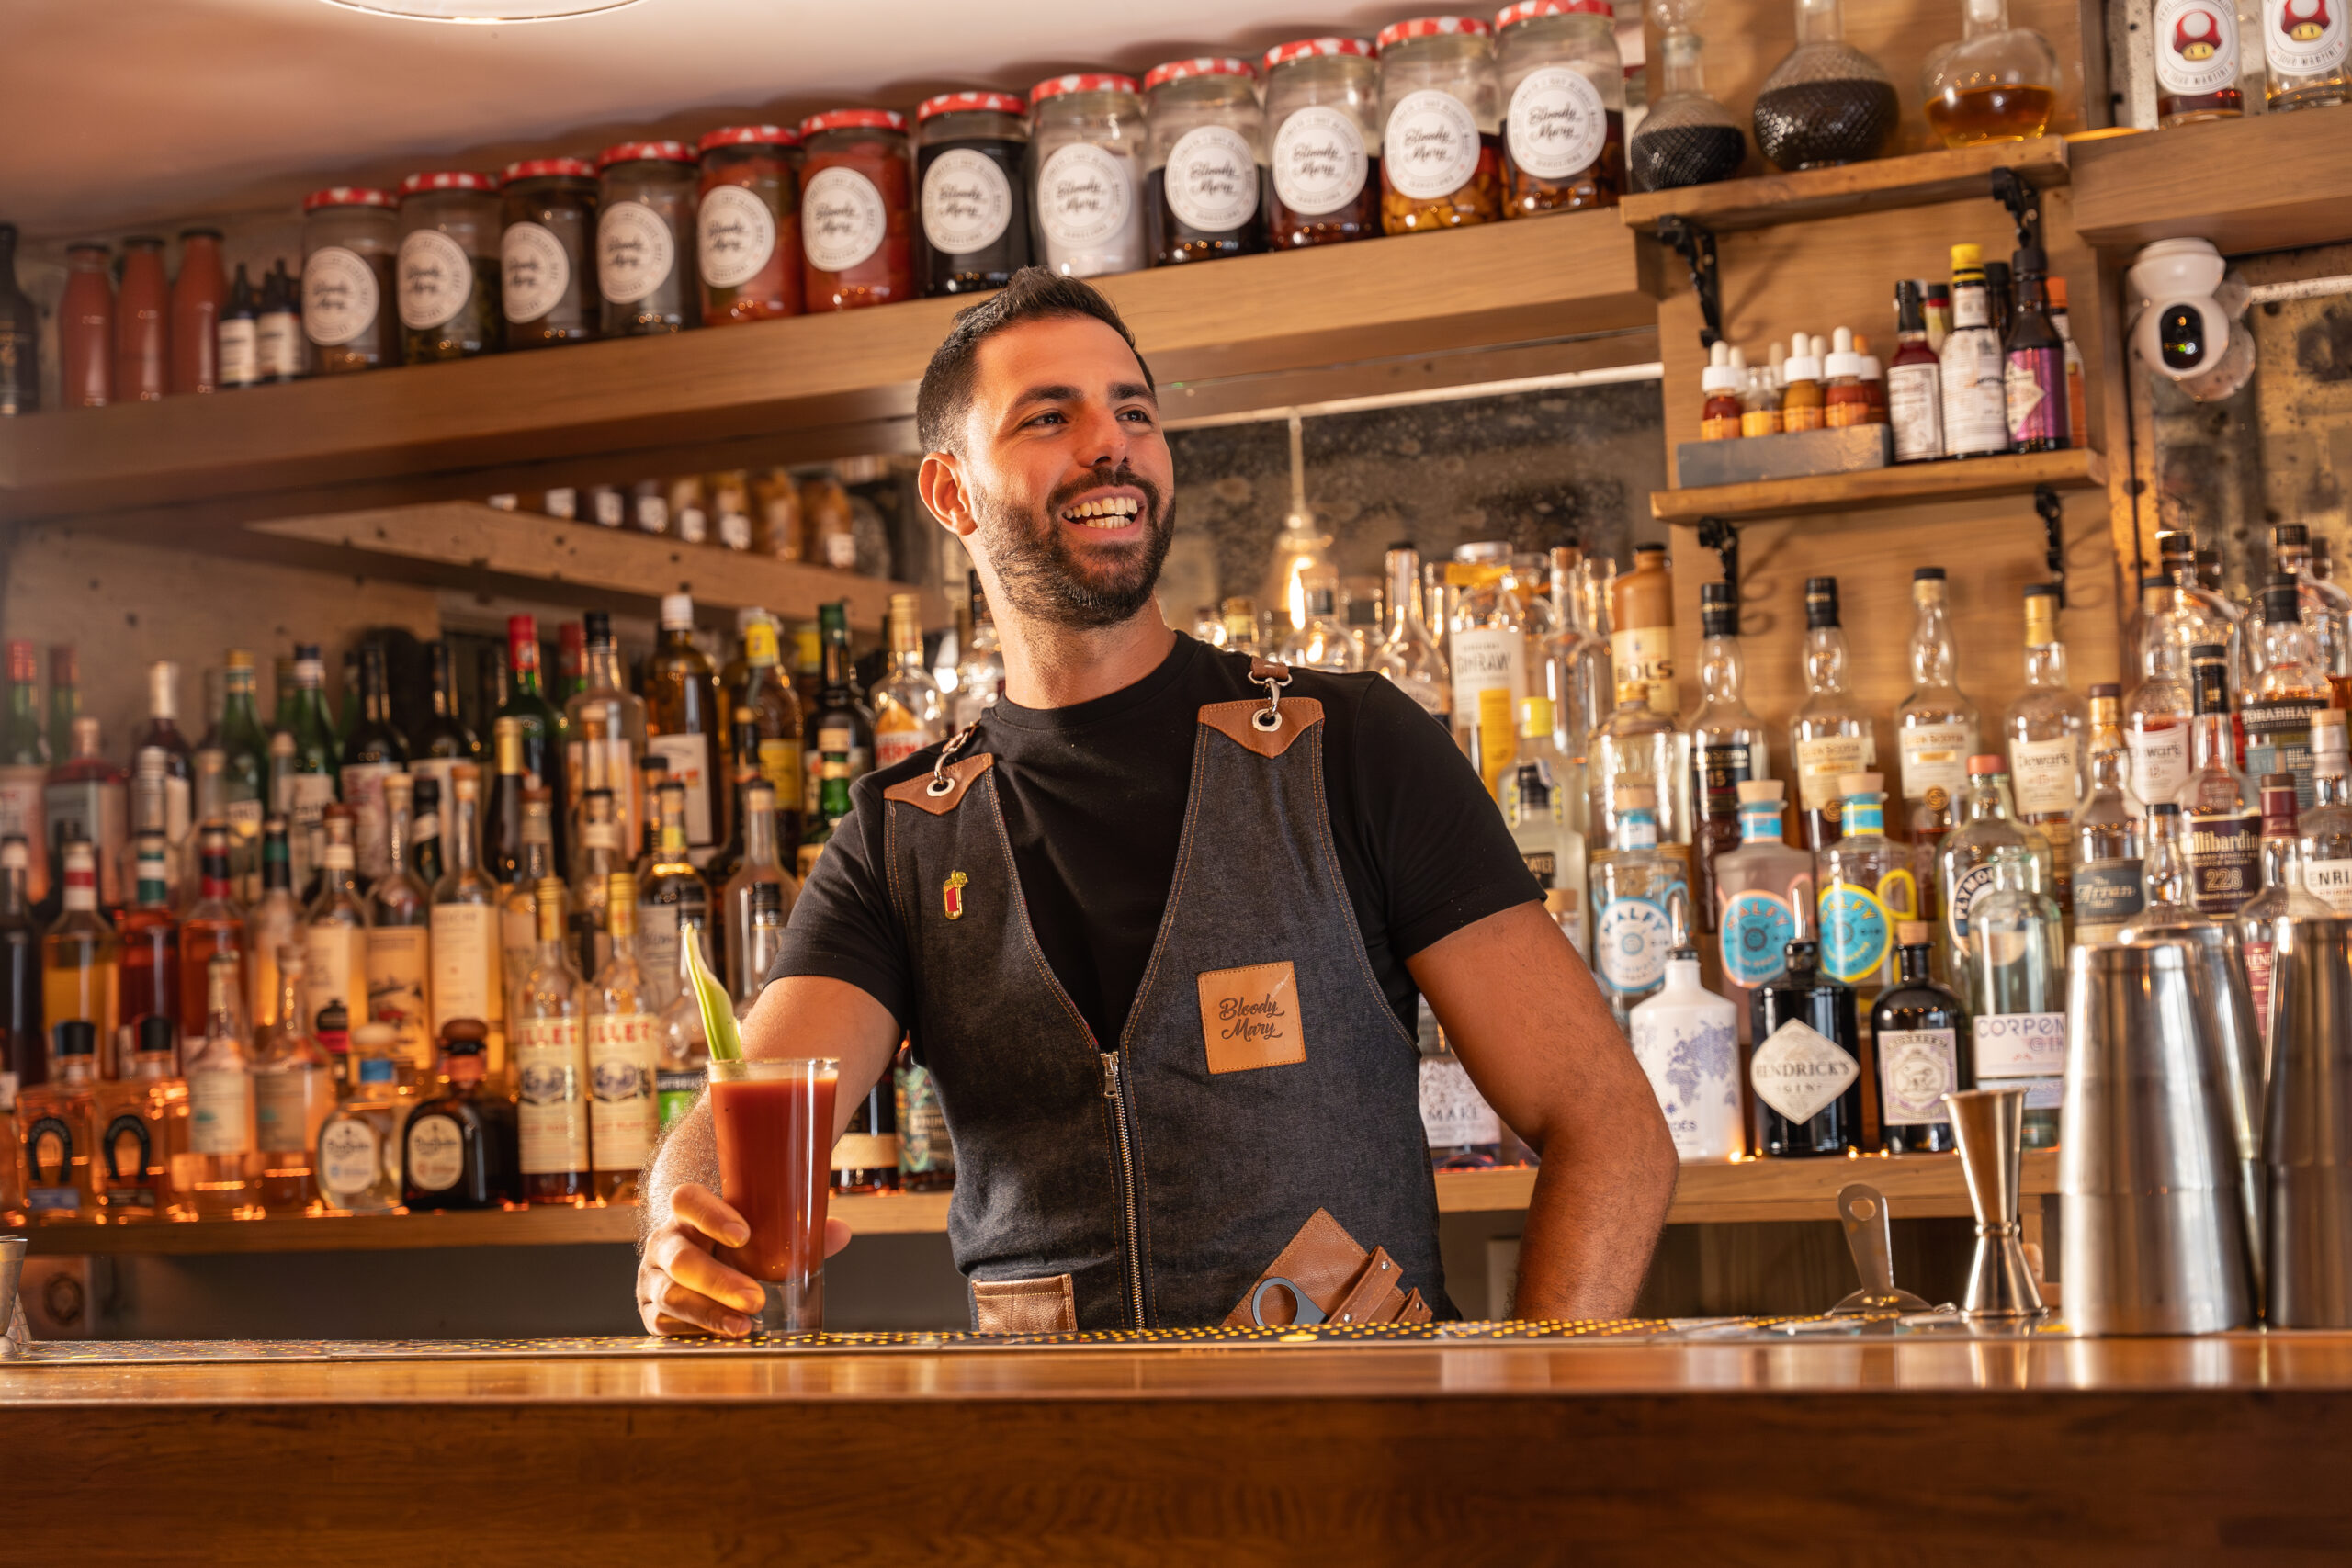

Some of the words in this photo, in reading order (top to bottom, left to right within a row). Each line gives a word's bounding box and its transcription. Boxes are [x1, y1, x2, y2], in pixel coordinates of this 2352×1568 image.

[1528, 102, 1583, 125] Bloody
[1404, 124, 1456, 146] Bloody
[1529, 123, 1580, 142] Mary
[1293, 141, 1344, 161] Bloody
[1403, 144, 1454, 163] Mary
[1190, 159, 1241, 179] Bloody
[1291, 160, 1341, 179] Mary
[1189, 179, 1239, 197] Mary
[2242, 705, 2320, 725] TORABHAI
[2205, 868, 2244, 892] 228
[1219, 993, 1284, 1021] Bloody
[1221, 1017, 1283, 1042] Mary
